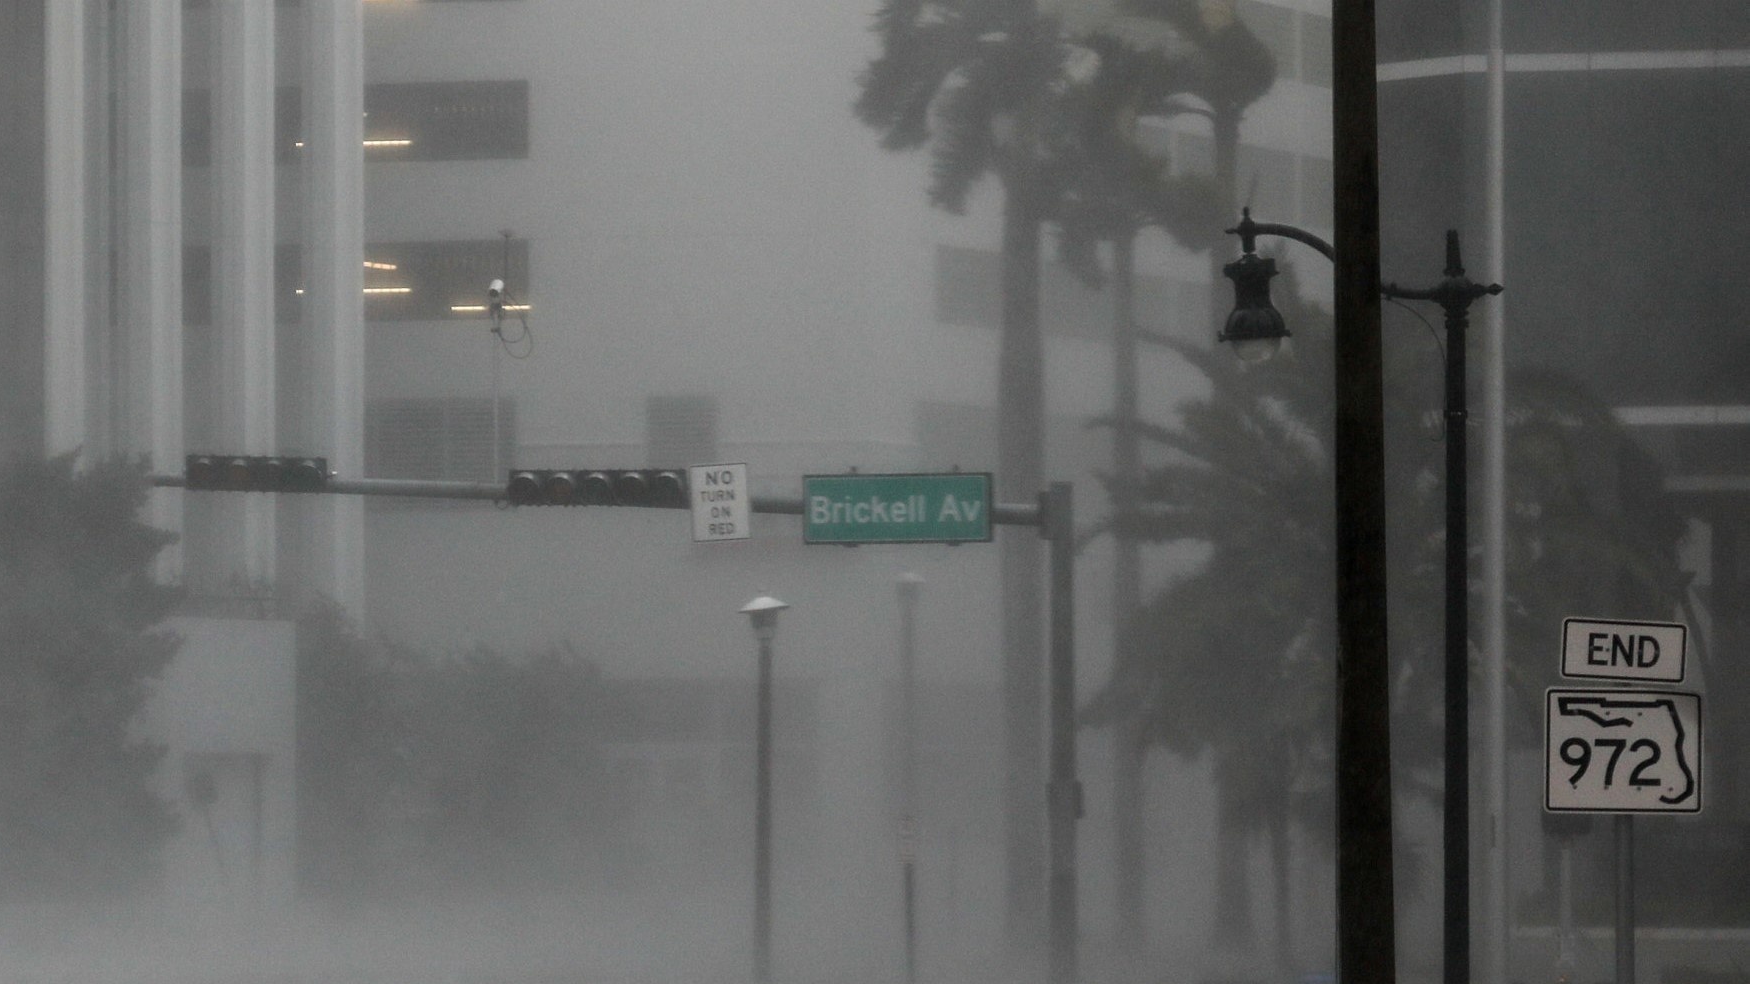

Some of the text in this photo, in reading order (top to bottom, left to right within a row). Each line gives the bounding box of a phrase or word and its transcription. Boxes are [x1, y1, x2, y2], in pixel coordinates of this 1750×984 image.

[705, 470, 732, 486] NO
[700, 489, 734, 503] TURN
[710, 506, 732, 519] ON
[810, 494, 981, 525] Brickell Av
[708, 522, 734, 536] RED
[1588, 632, 1661, 668] END
[1560, 737, 1661, 786] 972
